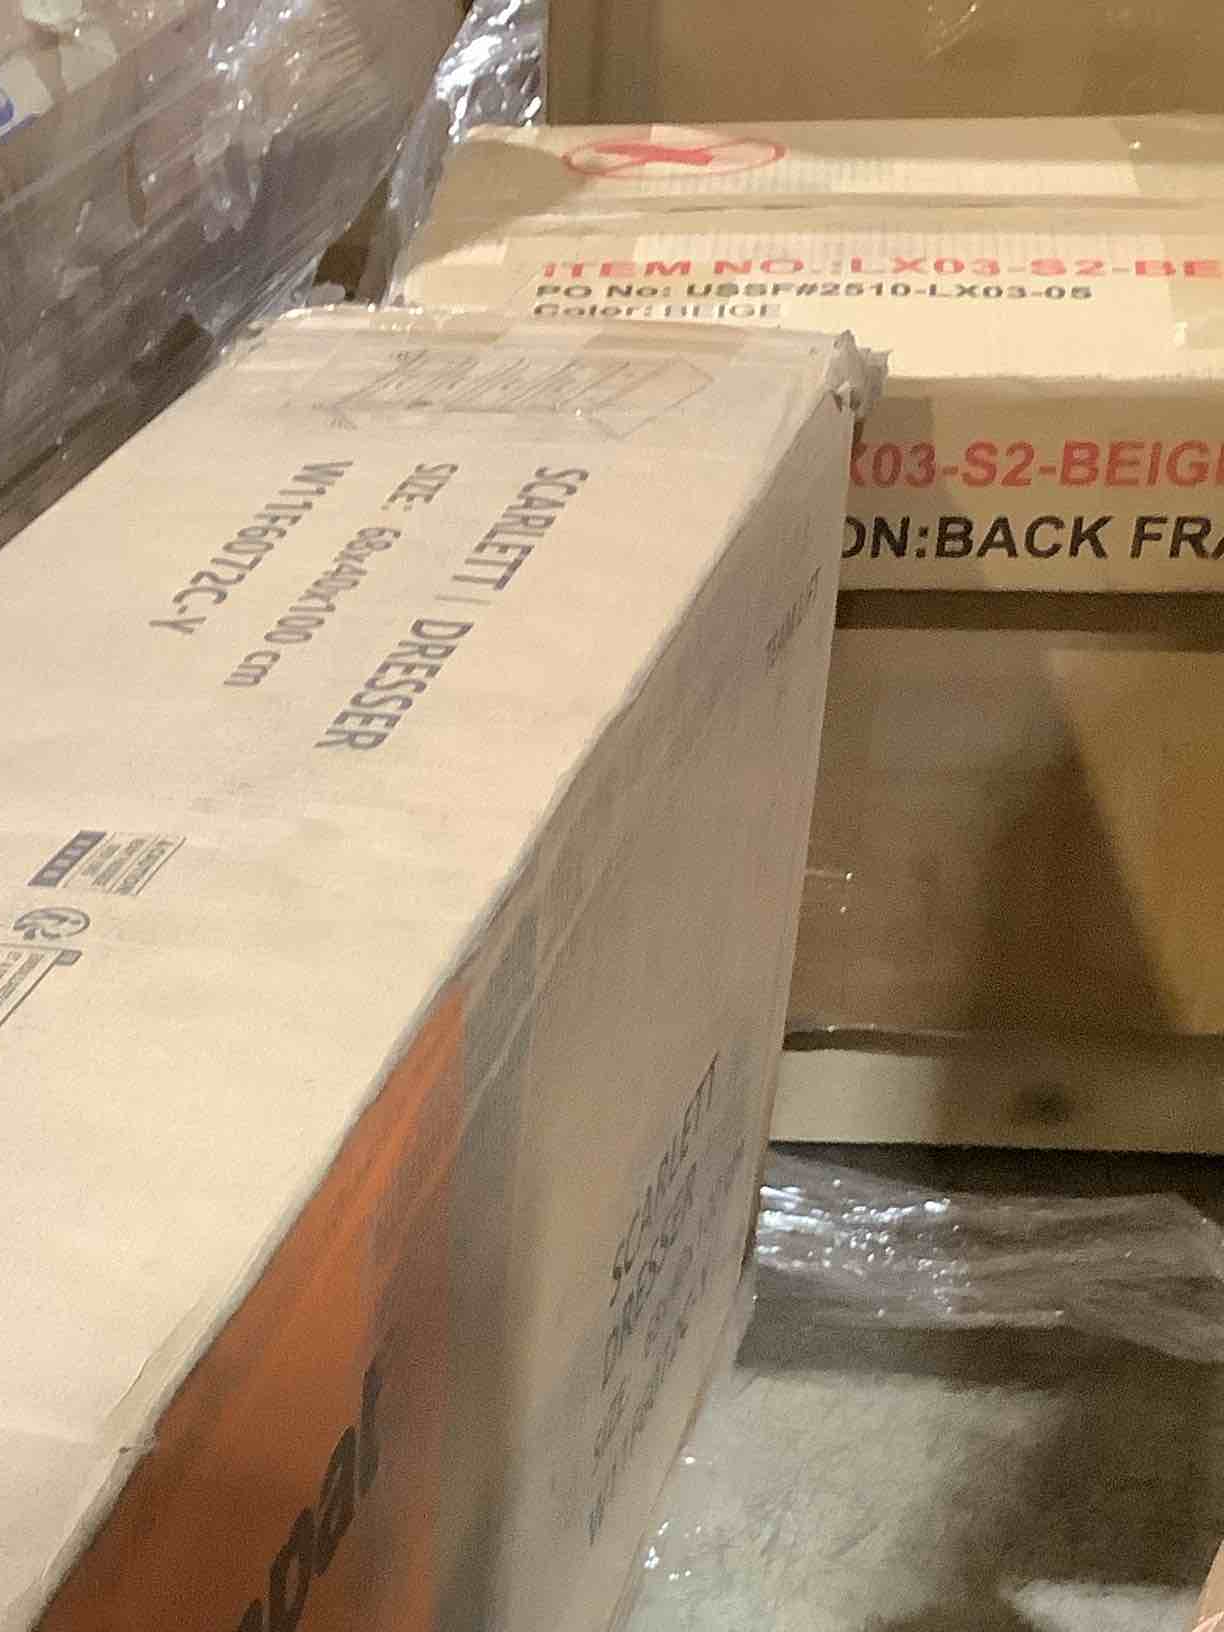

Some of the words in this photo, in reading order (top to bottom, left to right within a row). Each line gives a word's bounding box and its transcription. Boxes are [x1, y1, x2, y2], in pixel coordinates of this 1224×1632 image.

[535, 283, 593, 298] PO
[542, 259, 692, 279] ITEM
[380, 463, 459, 512] SIZE:
[451, 466, 590, 592] SCARLETT
[223, 650, 282, 688] cm
[313, 618, 475, 750] DRESSER
